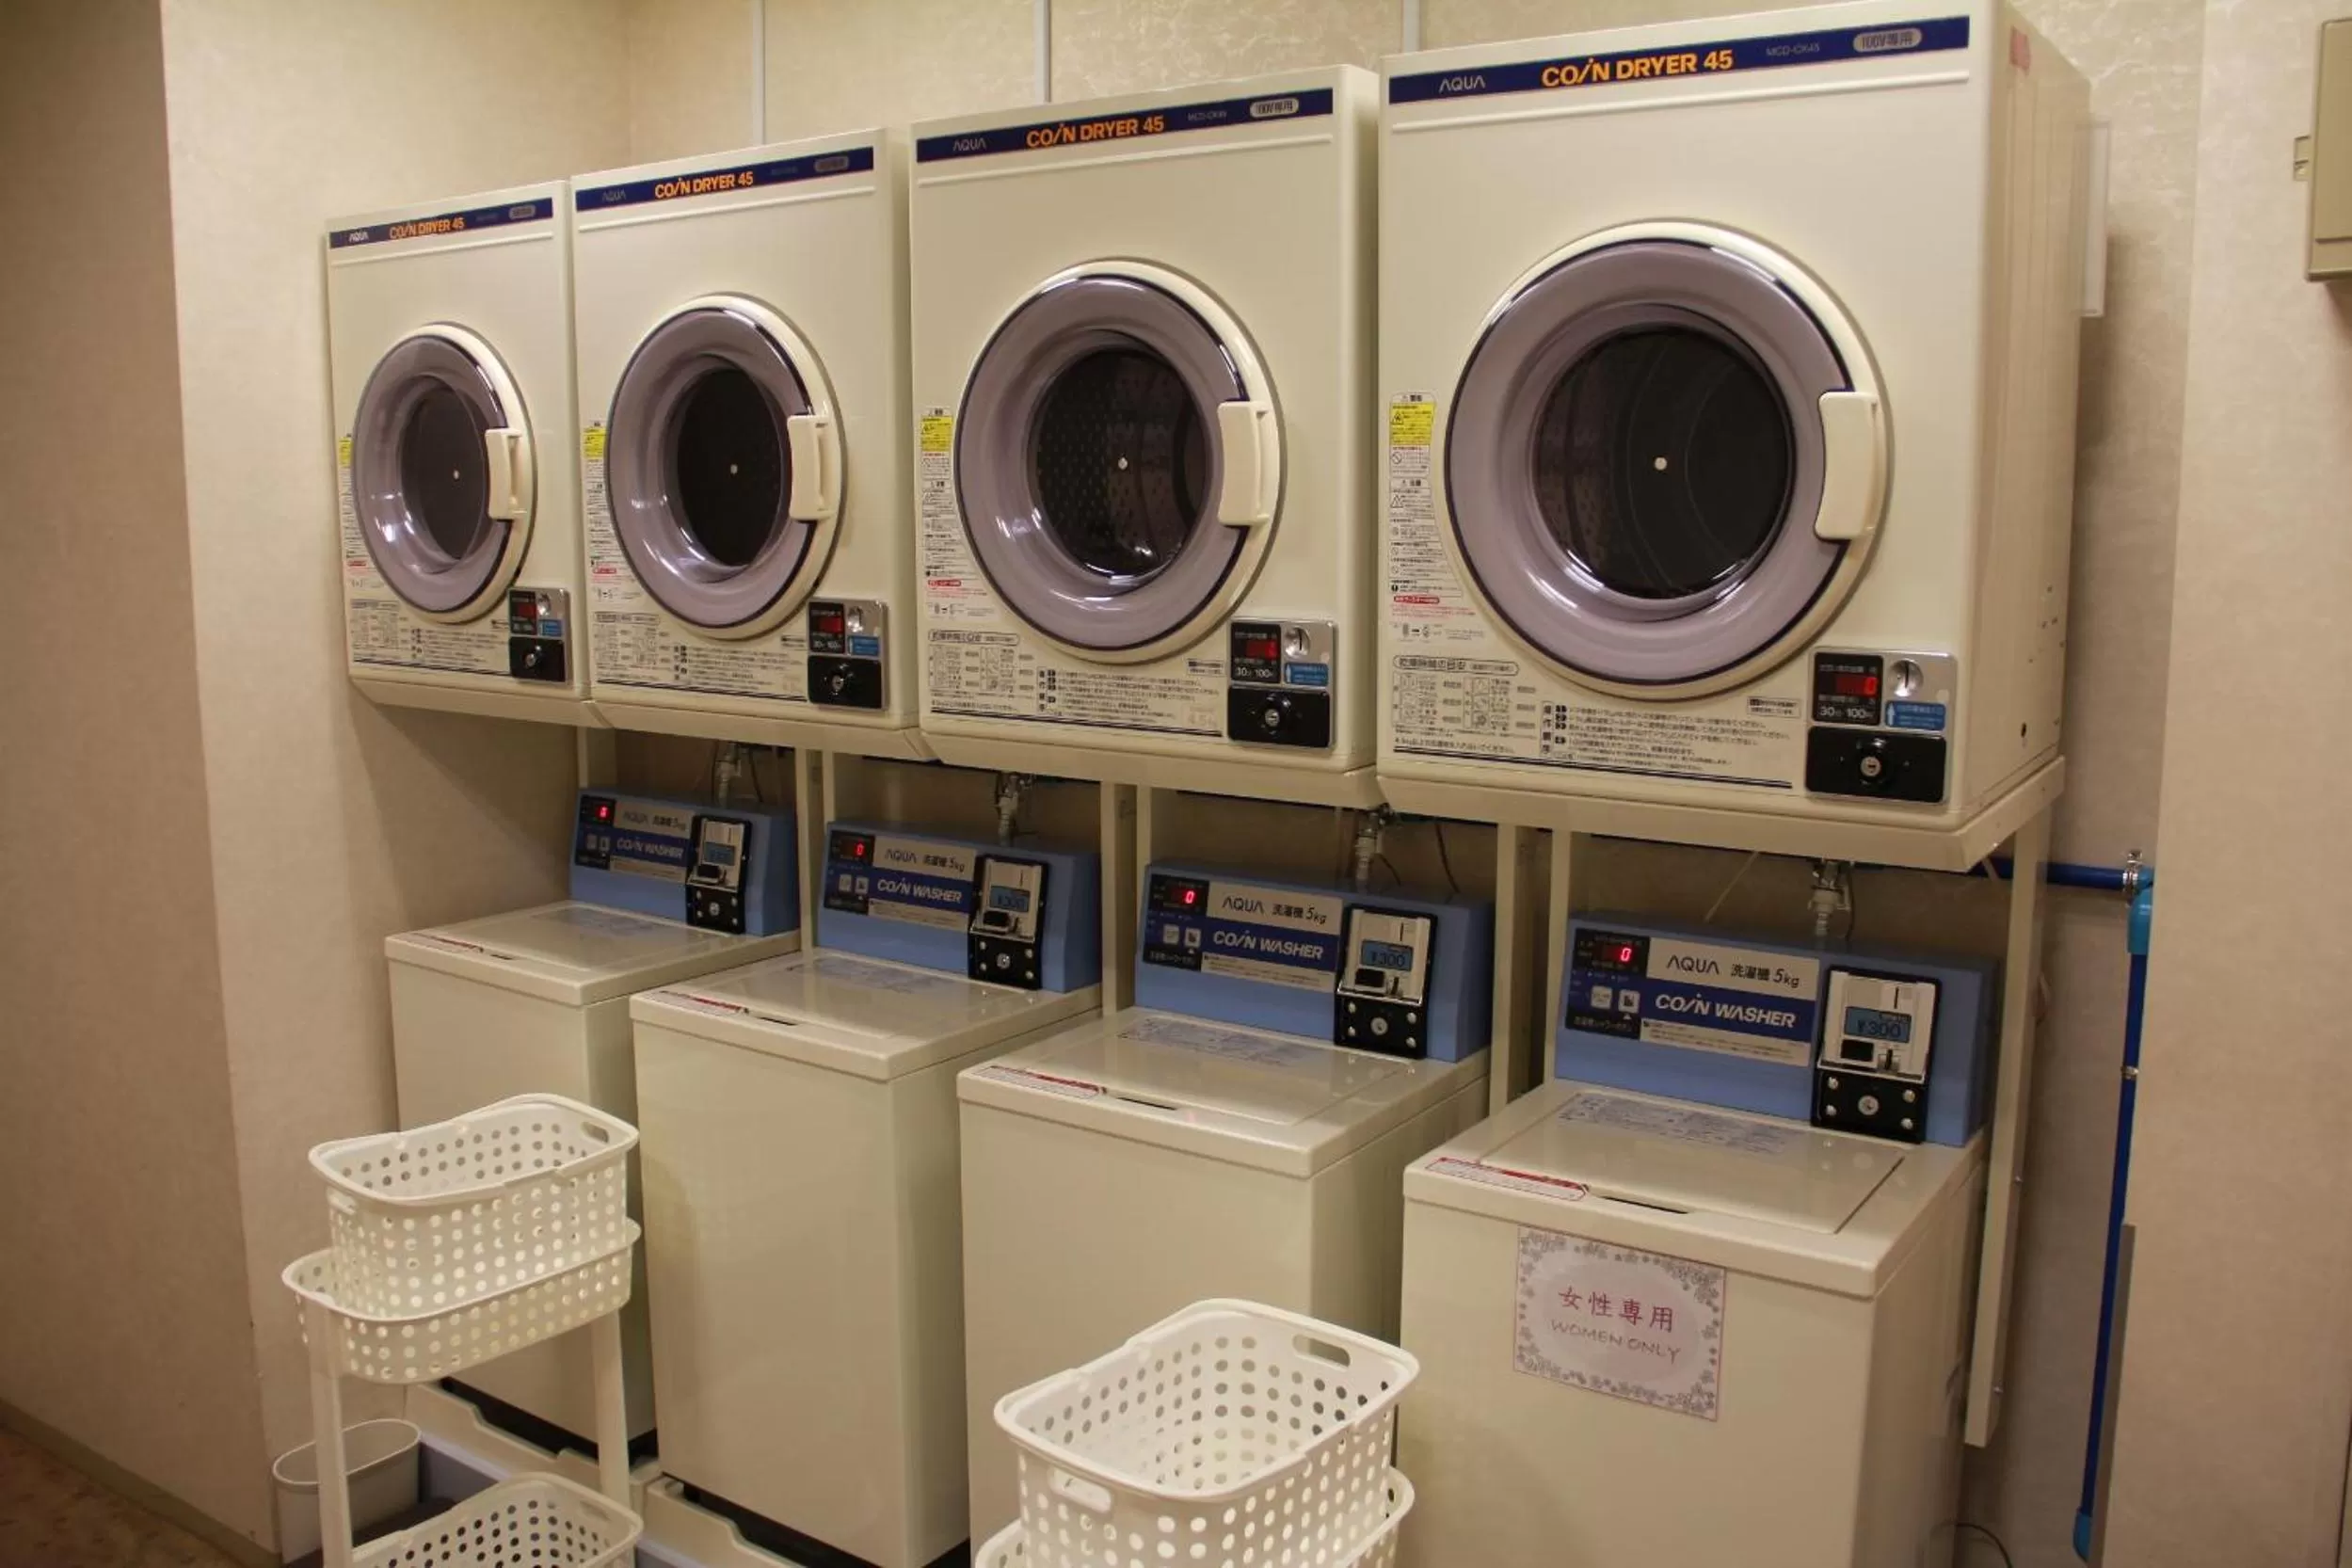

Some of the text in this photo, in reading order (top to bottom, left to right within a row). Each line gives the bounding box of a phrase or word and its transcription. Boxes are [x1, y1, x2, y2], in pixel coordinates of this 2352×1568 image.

[1616, 52, 1698, 80] DRYER
[1703, 49, 1734, 71] 45
[1438, 73, 1486, 93] AQUA
[1080, 118, 1139, 141] DRYER
[1143, 114, 1165, 134] 45
[952, 136, 987, 152] AQUA
[692, 173, 735, 196] DRYER
[736, 170, 754, 187] 45
[450, 216, 465, 231] 45
[913, 884, 963, 904] WASHER
[1185, 889, 1196, 904] 0
[1222, 894, 1265, 915] AQUA
[1305, 905, 1327, 925] 5kg
[1260, 936, 1324, 960] WASHER
[1620, 946, 1633, 962] 0
[1666, 953, 1720, 976] AQUA
[1772, 968, 1800, 989] 5kg
[1715, 1001, 1797, 1029] WASHER
[1558, 1285, 1674, 1334] 女性専用
[1550, 1318, 1682, 1366] WOMEN ONLY
